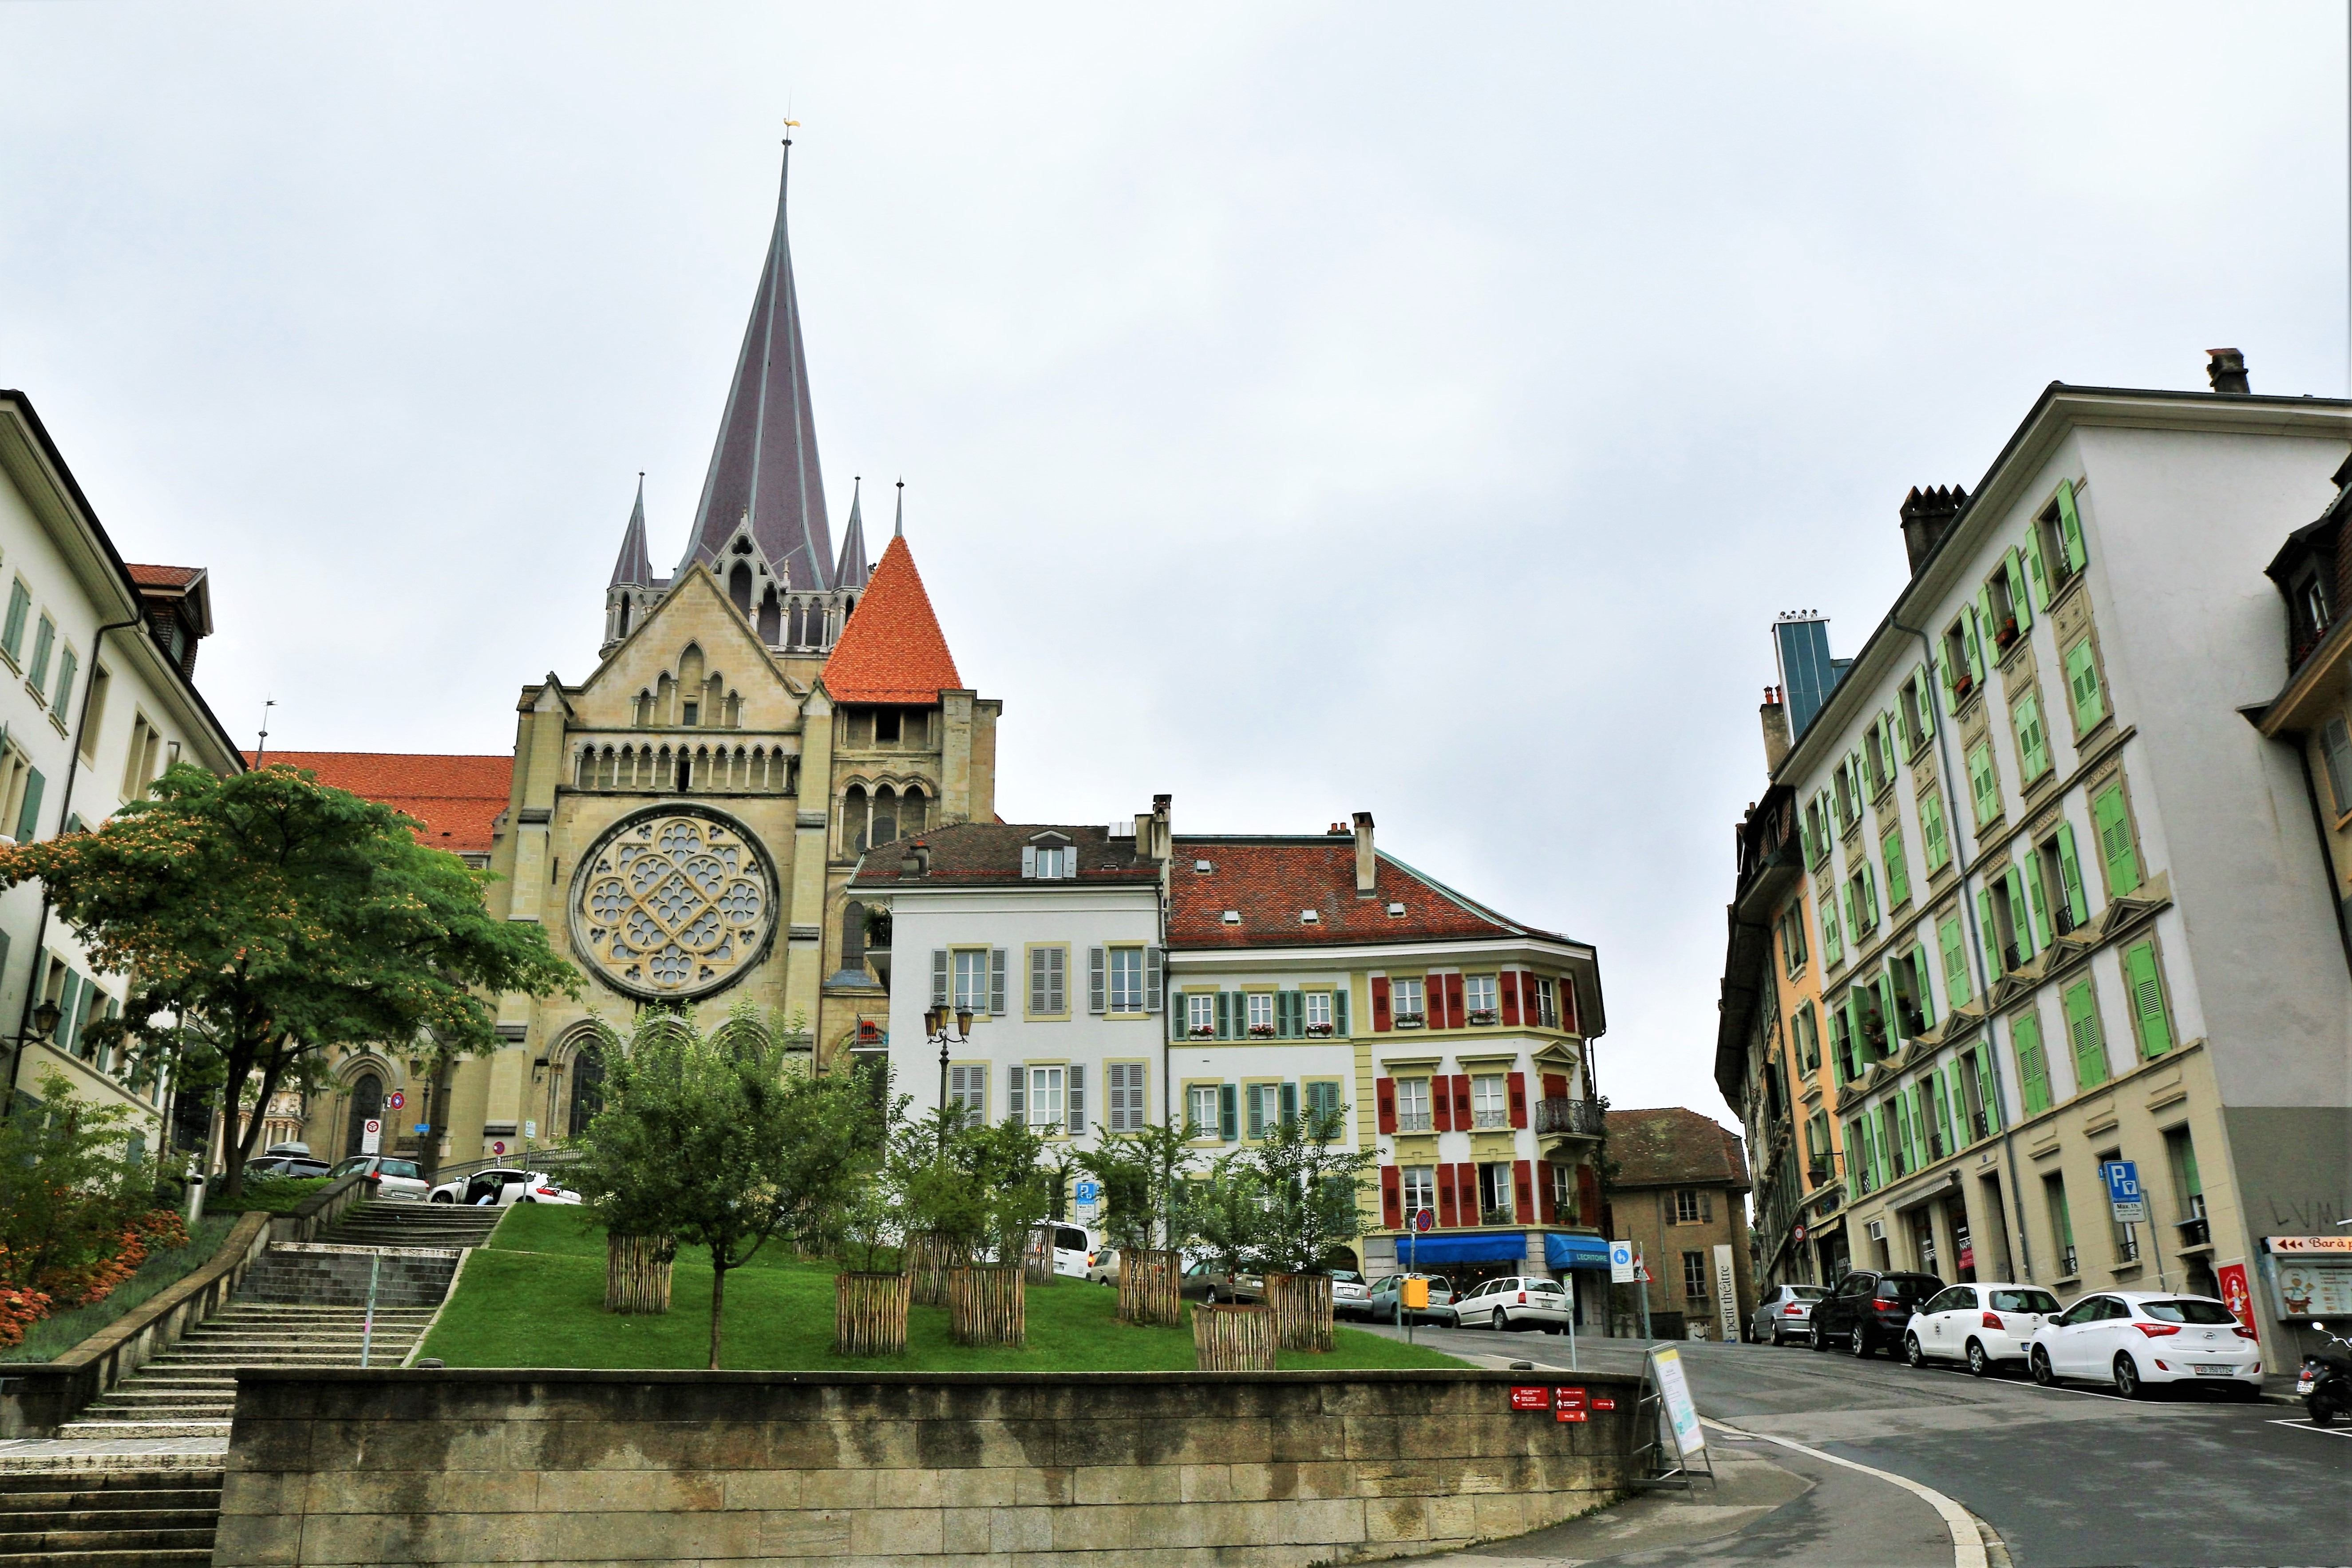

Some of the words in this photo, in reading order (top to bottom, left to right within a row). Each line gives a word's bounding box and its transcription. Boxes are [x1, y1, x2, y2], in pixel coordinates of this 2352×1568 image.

[2111, 1165, 2126, 1187] P
[2309, 1237, 2335, 1247] Bar
[2337, 1238, 2346, 1247] à
[1719, 1266, 1733, 1303] théâtre
[1723, 1307, 1739, 1332] petit
